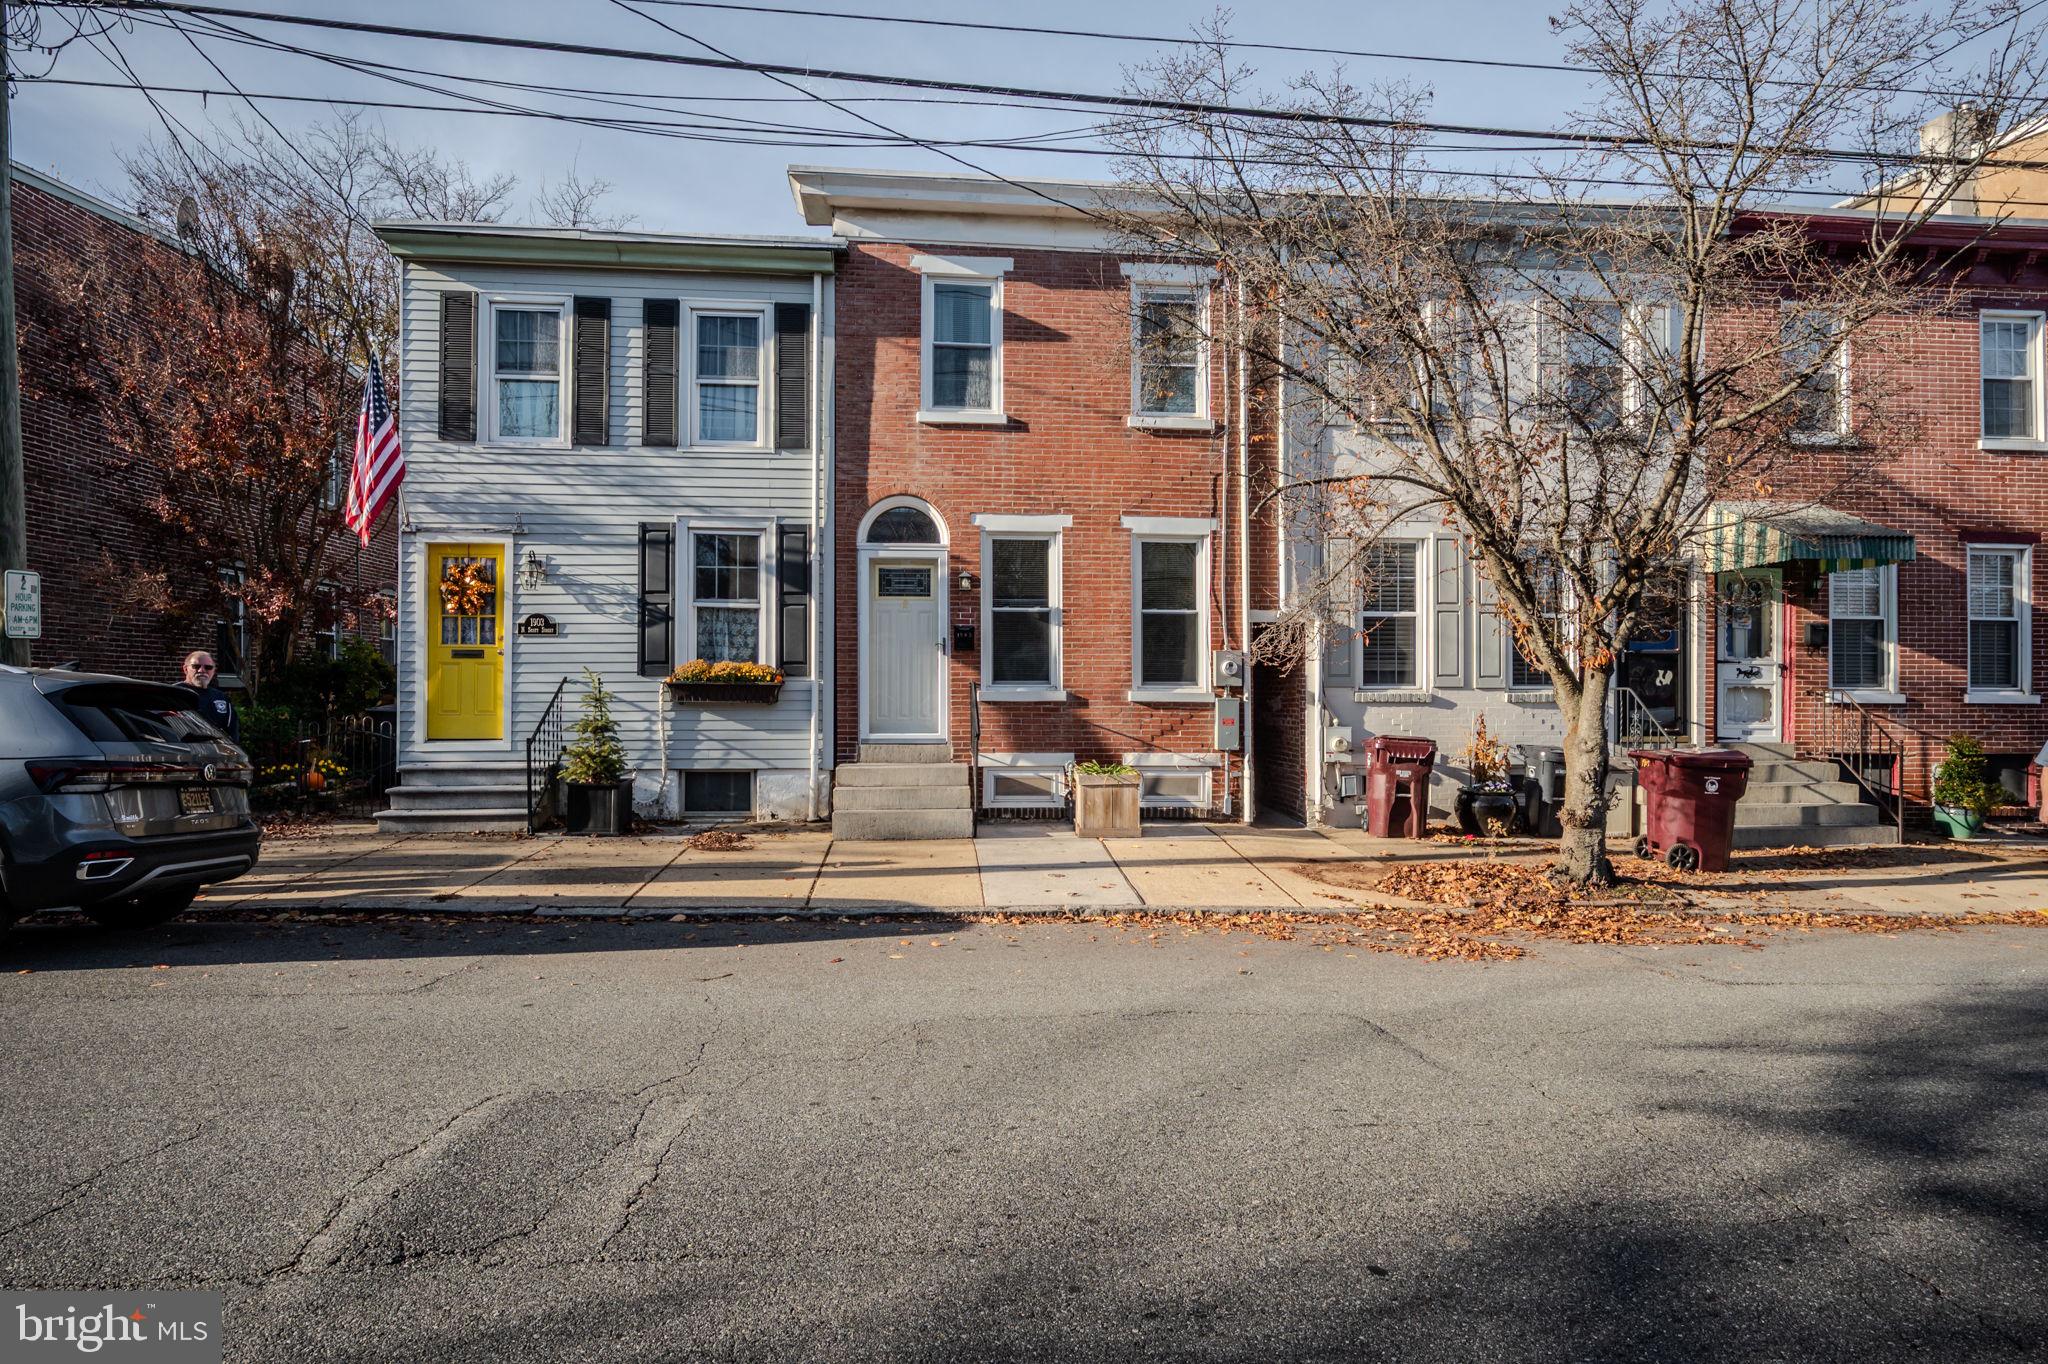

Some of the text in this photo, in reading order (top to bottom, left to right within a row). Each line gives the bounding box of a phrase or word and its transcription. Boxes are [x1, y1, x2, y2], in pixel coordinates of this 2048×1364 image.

[21, 580, 26, 590] 2
[15, 593, 32, 601] HOUR
[10, 603, 36, 612] PARKING
[530, 618, 545, 626] 1903
